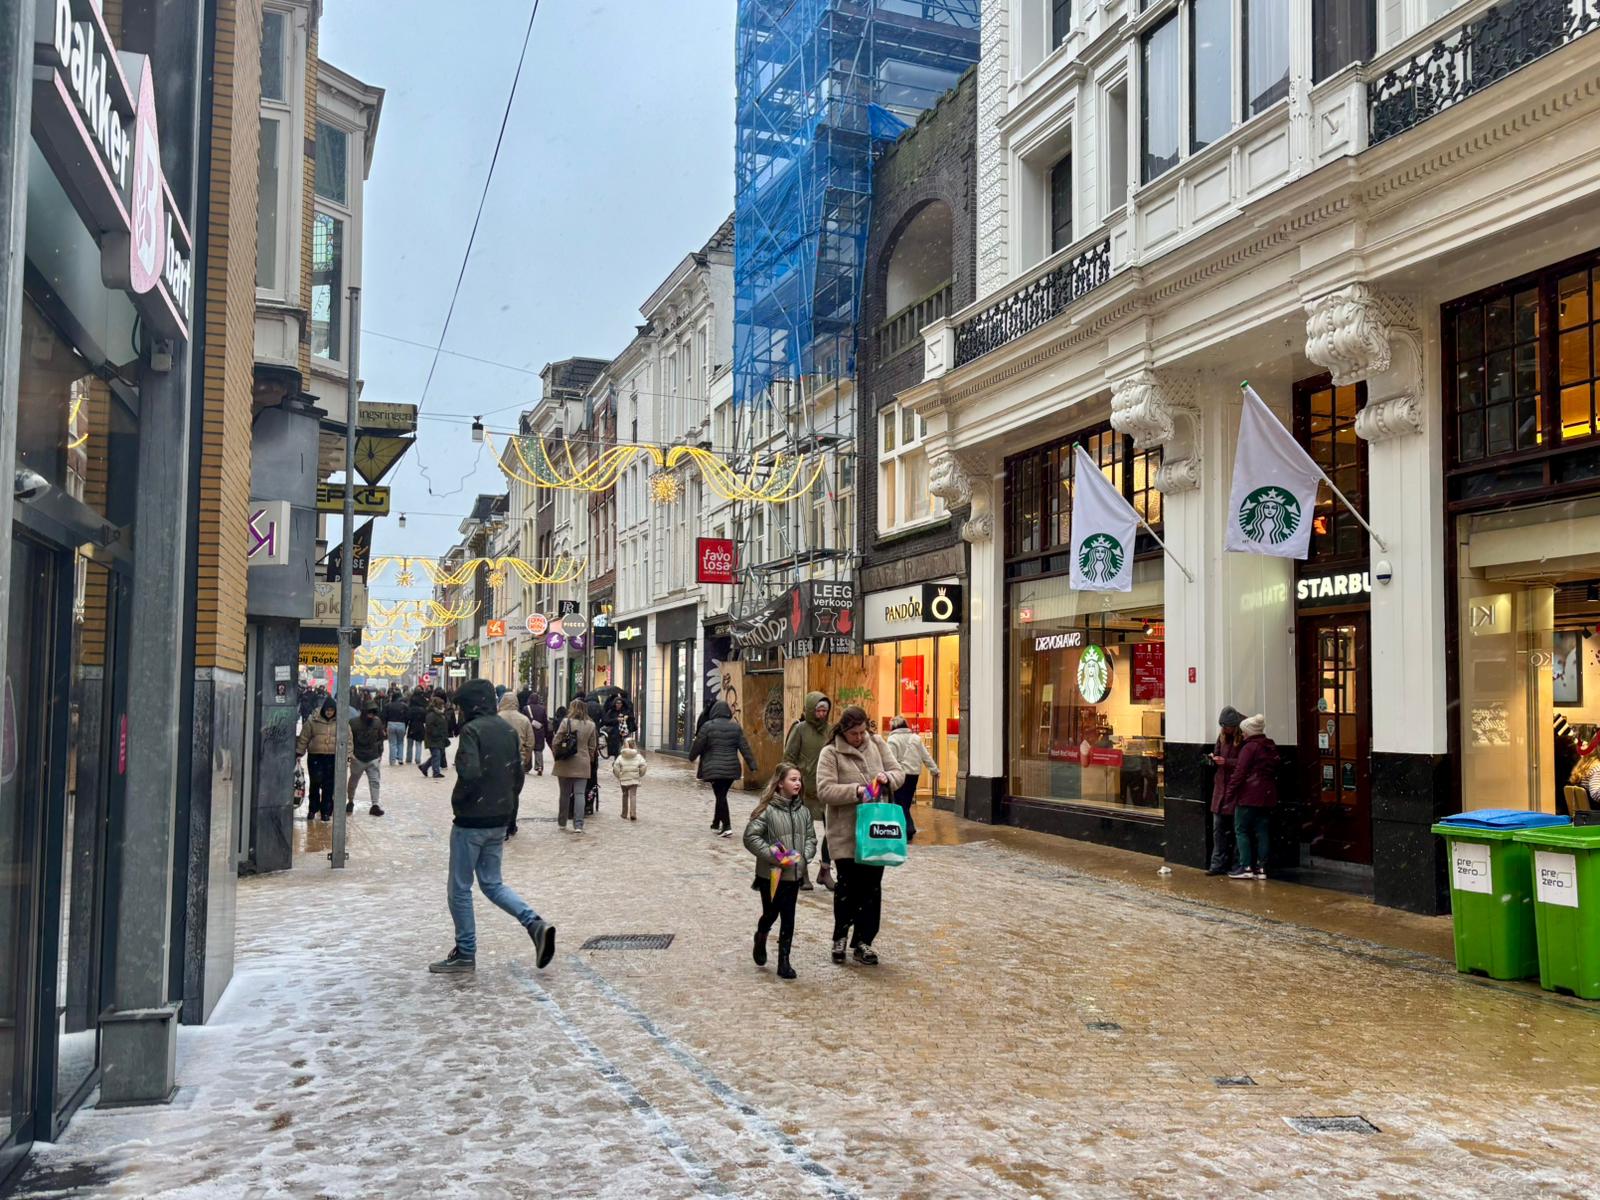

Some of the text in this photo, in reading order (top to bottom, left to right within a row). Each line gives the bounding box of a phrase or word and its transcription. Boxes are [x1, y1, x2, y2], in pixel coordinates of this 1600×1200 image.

[54, 0, 130, 190] bakker
[164, 211, 191, 320] bart
[703, 549, 731, 562] favo
[335, 558, 364, 569] VSE
[703, 560, 732, 571] losa
[814, 583, 852, 598] LEEG
[813, 598, 853, 608] verkoop
[885, 600, 923, 623] PANDOR
[873, 825, 899, 836] Normal
[1457, 858, 1472, 867] pre
[1457, 867, 1479, 876] zero
[1541, 869, 1557, 878] pre
[1542, 878, 1564, 888] zero
